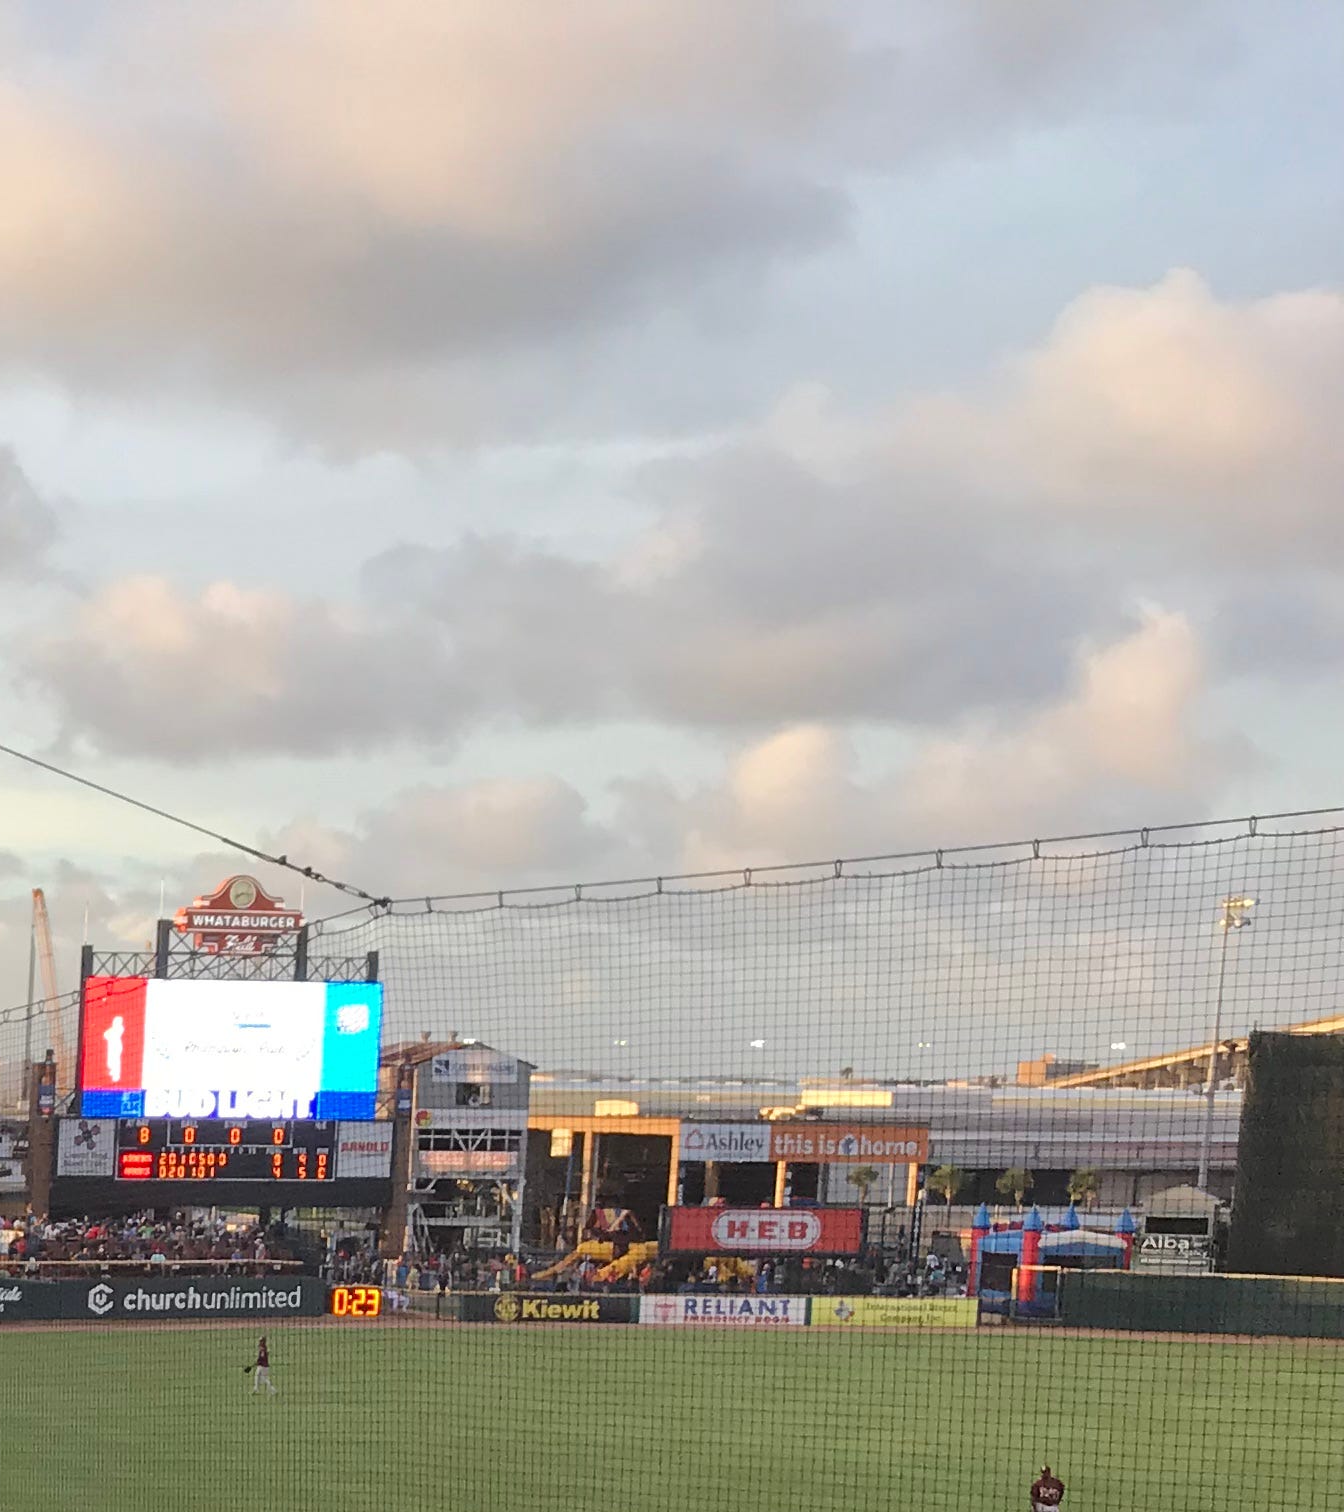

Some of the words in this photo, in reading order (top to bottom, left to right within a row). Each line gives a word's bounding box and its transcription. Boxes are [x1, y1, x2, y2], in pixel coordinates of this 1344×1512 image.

[192, 914, 295, 928] WHATABURGER
[145, 1087, 215, 1117] BUD
[218, 1087, 314, 1118] LIGHT
[184, 1127, 195, 1144] 0
[230, 1127, 241, 1144] 0
[273, 1127, 284, 1144] 0
[706, 1130, 763, 1152] Ashley
[774, 1133, 813, 1155] this
[818, 1133, 838, 1155] is
[340, 1141, 389, 1153] ARNOLD
[123, 1286, 301, 1311] churchunlimited
[332, 1288, 381, 1316] 0:23
[684, 1298, 791, 1315] RELIANT
[522, 1298, 600, 1319] Kiewit
